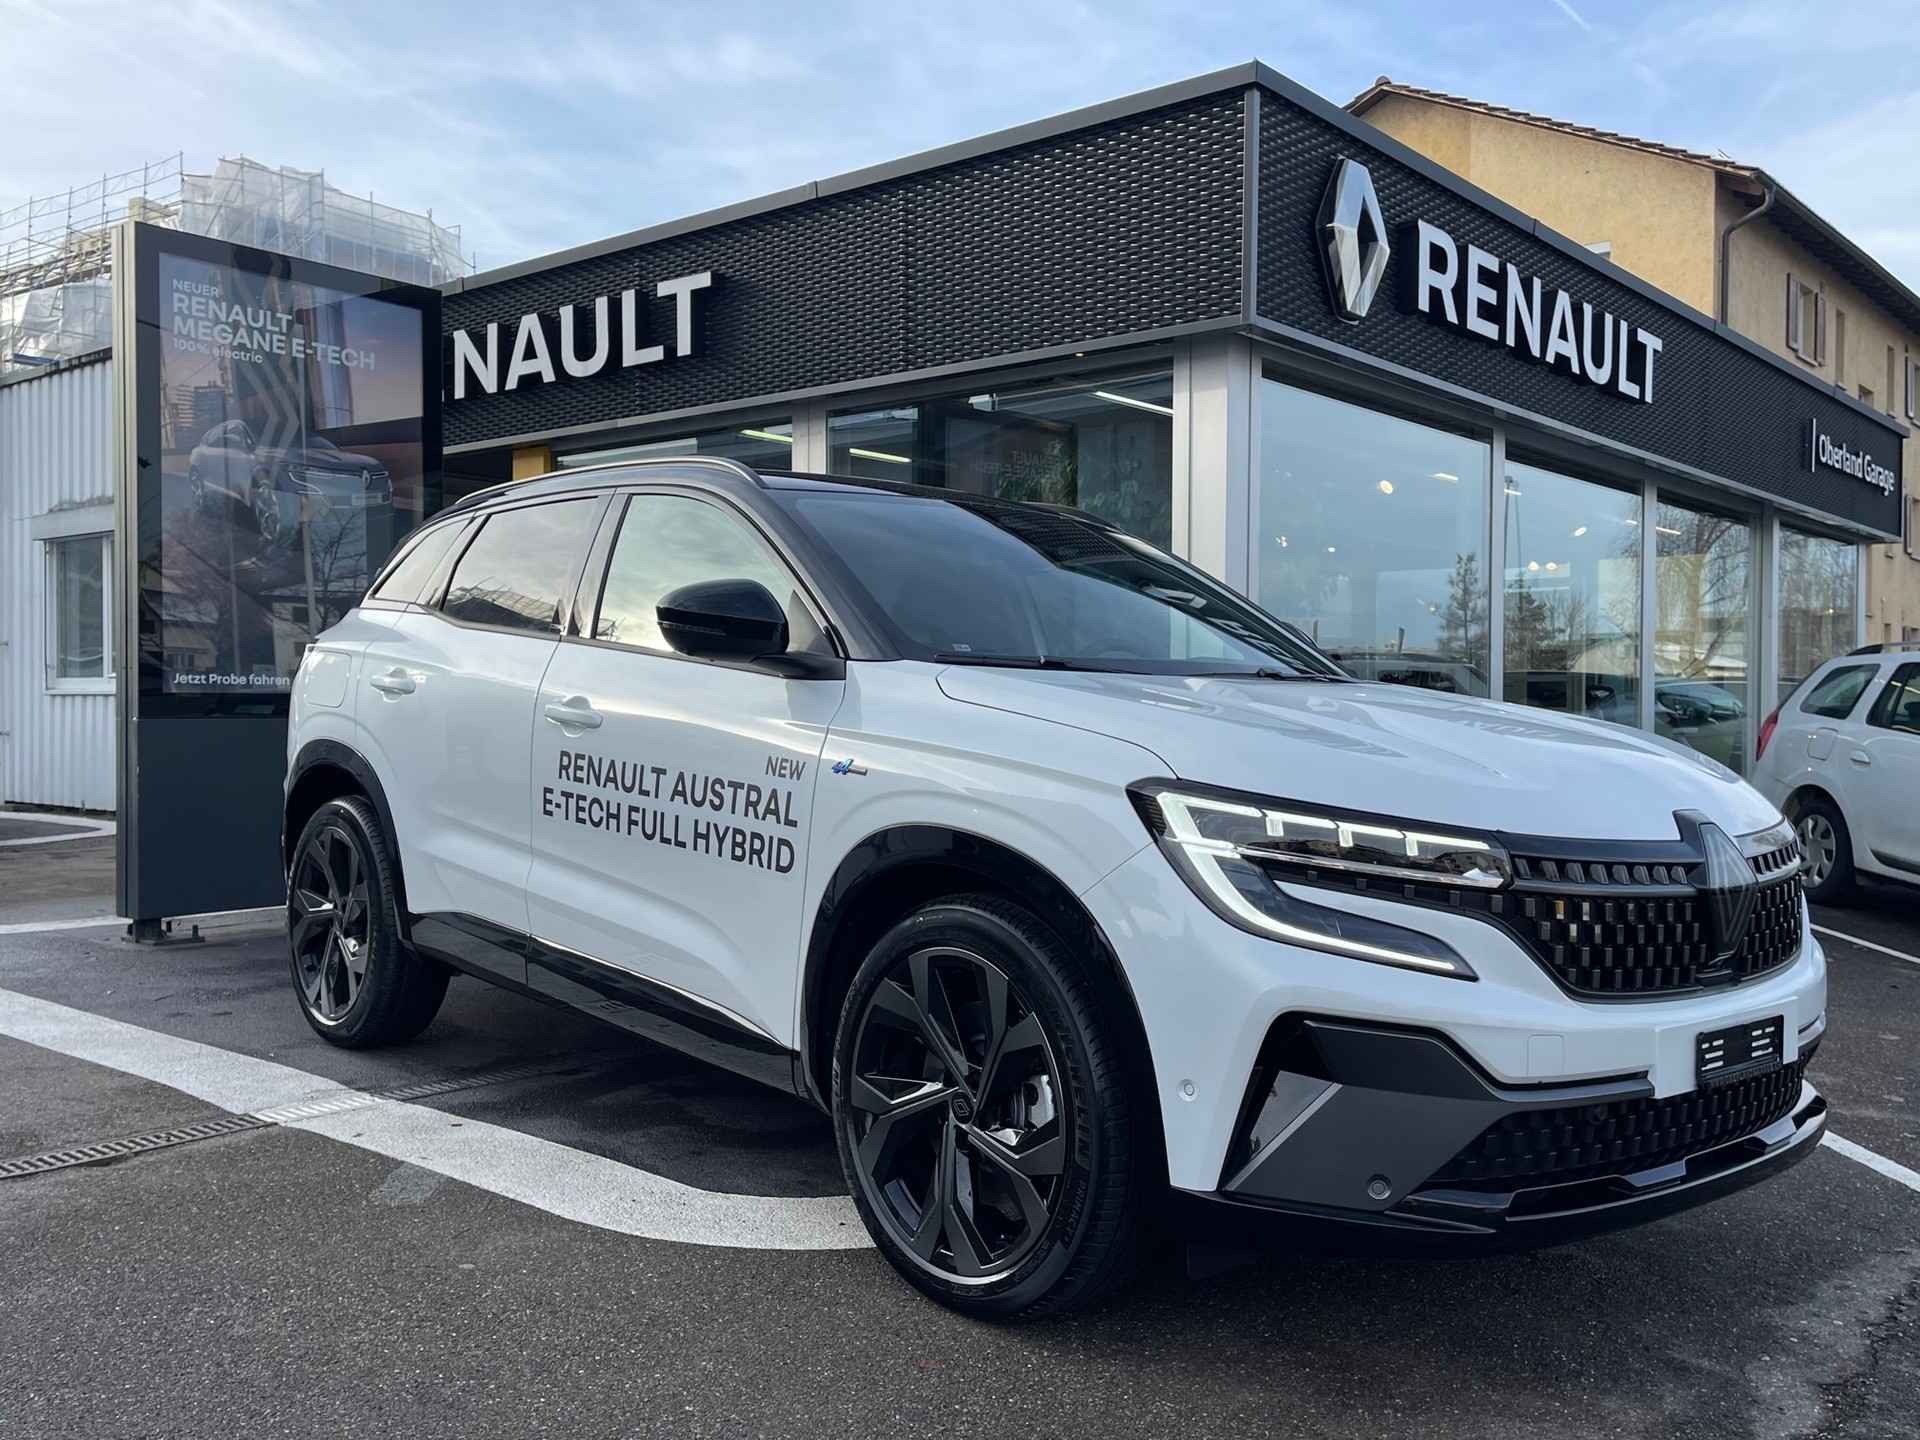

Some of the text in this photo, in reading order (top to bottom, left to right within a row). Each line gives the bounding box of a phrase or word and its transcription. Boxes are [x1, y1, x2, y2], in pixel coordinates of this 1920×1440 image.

[172, 279, 220, 298] NEUER
[173, 292, 293, 334] RENAULT
[1418, 219, 1662, 404] RENAULT
[173, 316, 375, 371] MEGANE E-TECH
[173, 337, 263, 364] 100% electric
[442, 271, 711, 402] NAULT
[1819, 434, 1894, 496] Oberland Garage
[173, 673, 290, 686] Jetzt Probe fahren
[558, 750, 799, 828] RENAULT AUSTRAL
[765, 756, 806, 781] NEW
[543, 787, 795, 874] E-TECH FULL HYBRID
